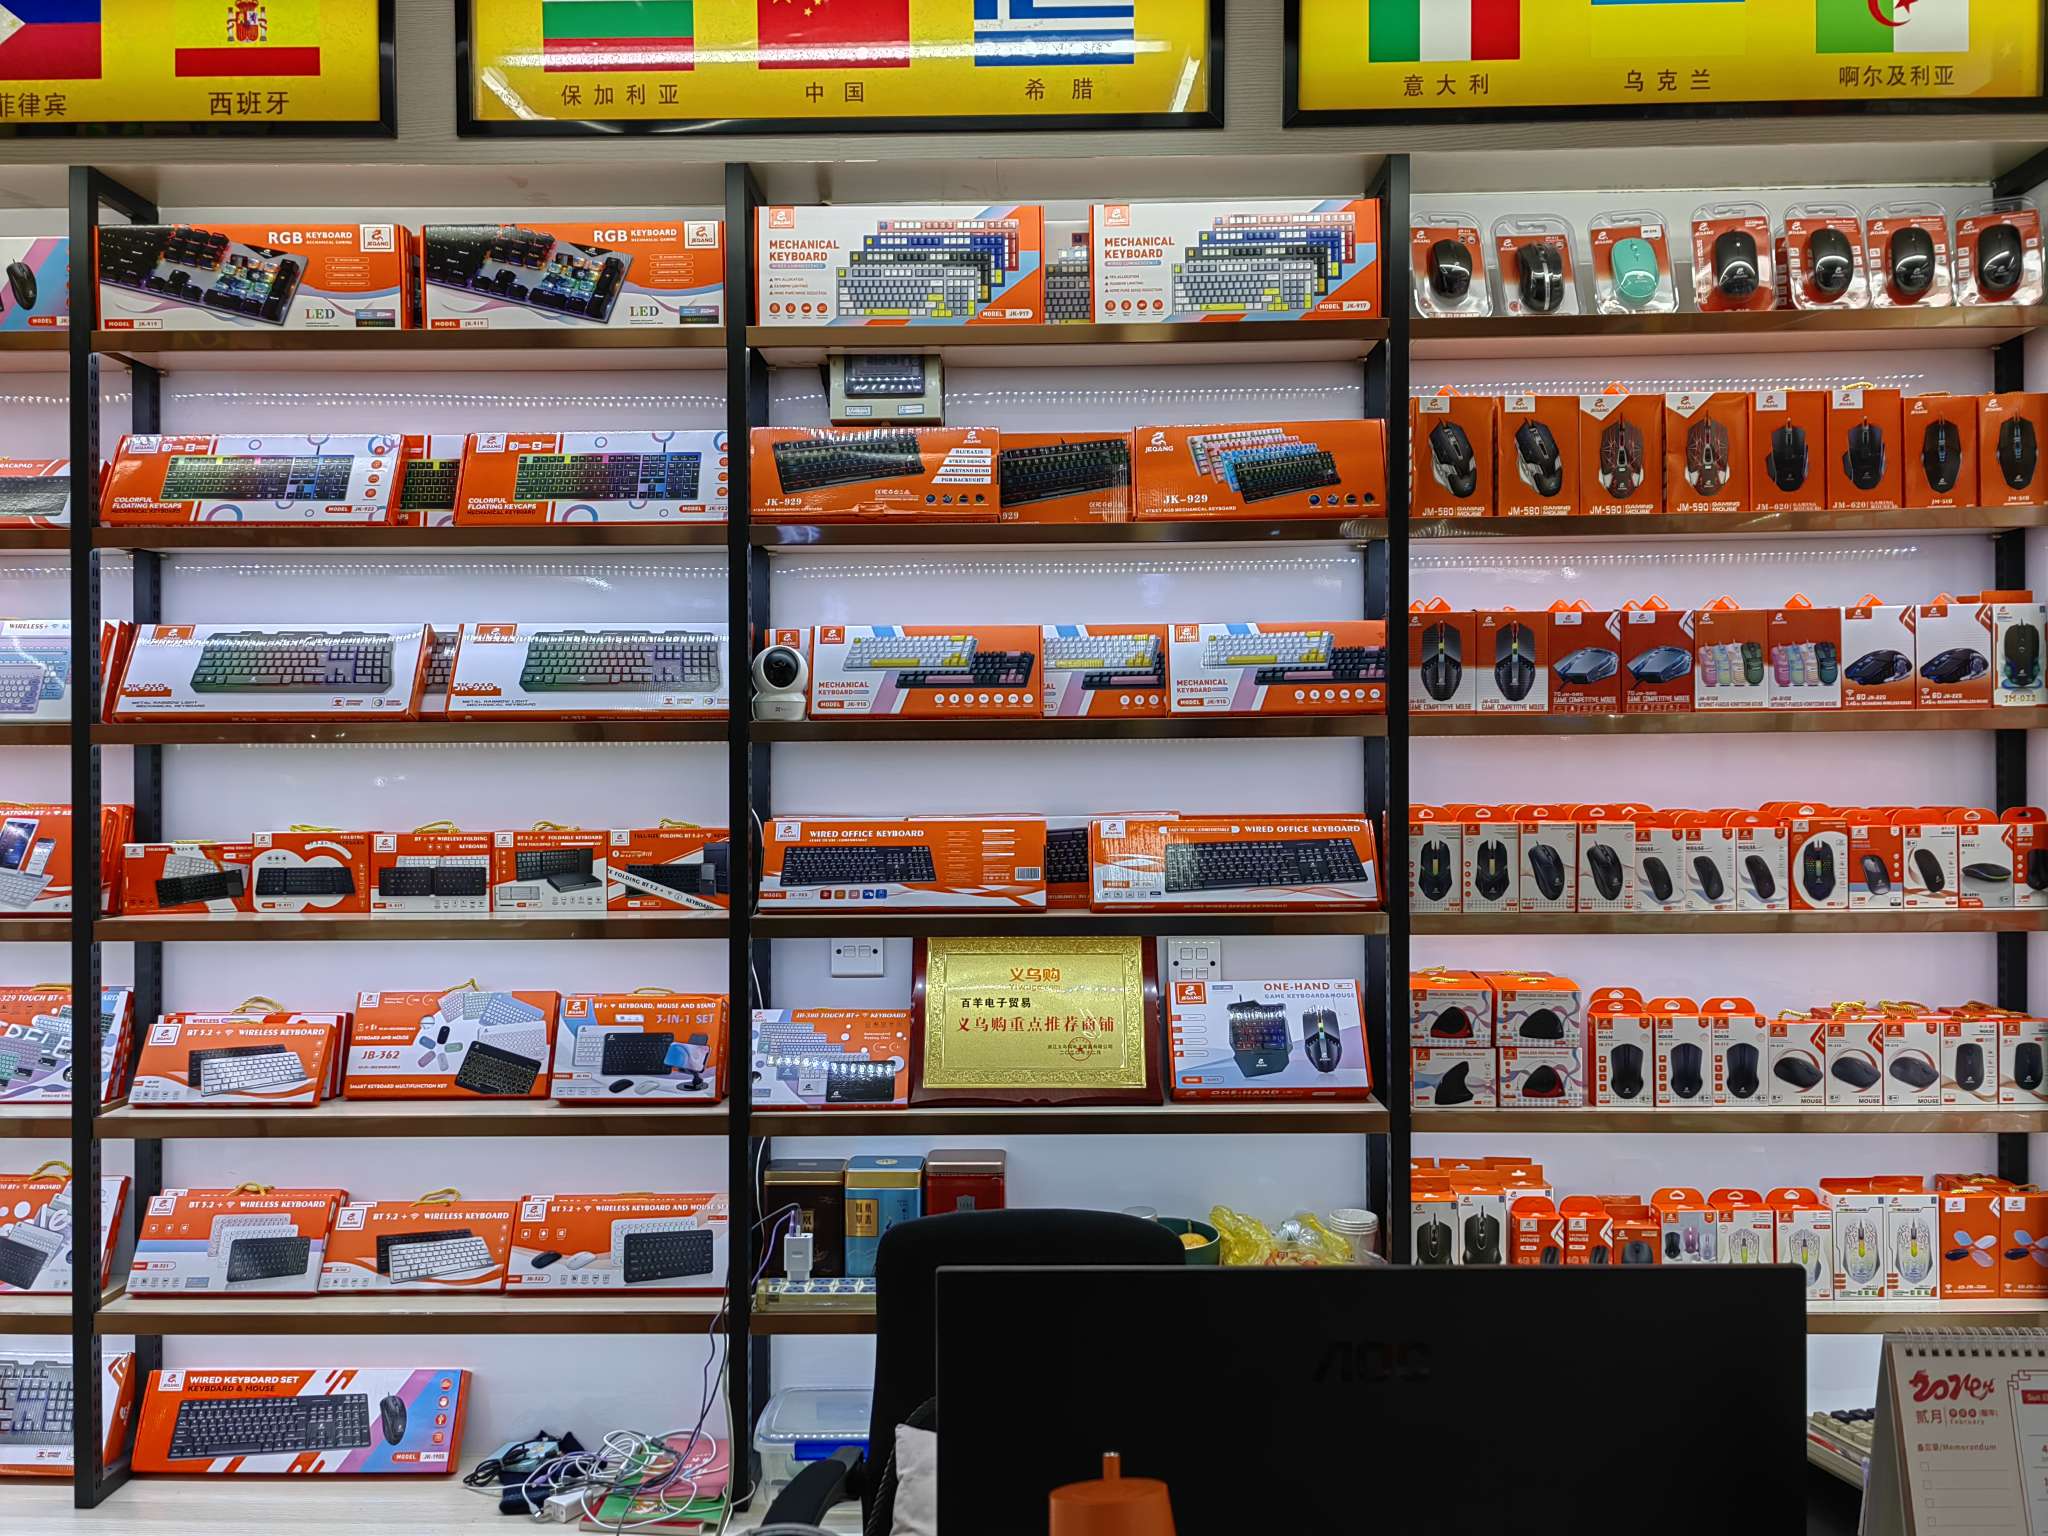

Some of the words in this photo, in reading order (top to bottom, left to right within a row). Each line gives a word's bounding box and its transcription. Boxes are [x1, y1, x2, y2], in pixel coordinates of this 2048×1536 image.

[1403, 73, 1491, 96] 意大利
[1623, 69, 1712, 92] 乌克兰
[560, 83, 680, 106] 保加利亚
[804, 80, 866, 104] 中国
[1025, 78, 1094, 102] 希腊
[207, 91, 290, 116] 西班牙
[267, 231, 304, 245] RGB
[305, 231, 353, 239] KEYBOARD
[594, 229, 628, 244] RGB
[630, 228, 678, 238] KEYBOARD
[769, 239, 841, 250] MECHANICAL
[1104, 236, 1175, 248] MECHANICAL
[769, 251, 829, 262] KEYBOARD
[1104, 248, 1164, 259] KEYBOARD
[629, 305, 661, 318] LED
[1319, 303, 1341, 311] MODEL
[304, 308, 336, 320] LED
[982, 310, 1004, 318] MODEL
[31, 317, 53, 325] MODEL
[1144, 445, 1174, 454] JEQANG
[114, 496, 153, 504] COLORFUL
[764, 497, 803, 507] JK-929
[1162, 493, 1209, 505] JK-929
[1422, 507, 1454, 517] JM-580
[1508, 506, 1540, 516] JM-580
[1589, 506, 1622, 515] JM-590
[1676, 502, 1709, 512] JM-590
[124, 682, 167, 693] JK-918
[453, 682, 498, 693] JK-918
[818, 680, 870, 689] MECHANICAL
[1176, 679, 1228, 687] MECHANICAL
[820, 701, 842, 709] MODEL
[809, 830, 839, 838] WIRED
[876, 829, 925, 837] KEYBOARD
[1244, 825, 1274, 834] WIRED
[1276, 825, 1310, 833] OFFICE
[1312, 824, 1361, 833] KEYBOARD
[613, 871, 640, 885] FOLDING
[1009, 967, 1061, 982] 义乌购
[1263, 982, 1331, 991] ONE-HAND
[960, 997, 1032, 1009] 百羊电子贸易
[655, 1014, 691, 1025] 3-IN-1
[695, 1013, 715, 1025] SET
[957, 1015, 1115, 1033] 义乌购重点推荐商铺
[186, 1028, 199, 1036] BT
[200, 1028, 213, 1036] 5.2
[238, 1028, 279, 1036] WIRELESS
[279, 1027, 325, 1036] KEYBOARD
[361, 1050, 401, 1060] JB-362
[1917, 1097, 1940, 1105] MOUSE
[188, 1201, 200, 1209] BT
[201, 1201, 214, 1209] 5.2
[239, 1200, 280, 1209] WIRELESS
[281, 1200, 326, 1209] KEYBOARD
[595, 1204, 626, 1212] WIRELESS
[626, 1204, 667, 1212] KEYBOARD
[689, 1203, 716, 1211] MOUSE
[373, 1212, 384, 1220] BT
[385, 1212, 398, 1220] 5.2
[424, 1212, 464, 1220] WIRELESS
[465, 1211, 510, 1220] KEYBOARD
[1311, 1339, 1433, 1384] AOC
[189, 1375, 223, 1385] WIRED
[224, 1375, 278, 1384] KEYBOARD
[279, 1374, 300, 1384] SET
[235, 1384, 243, 1392] &
[244, 1383, 275, 1392] MOUSE
[396, 1453, 417, 1461] MODEL
